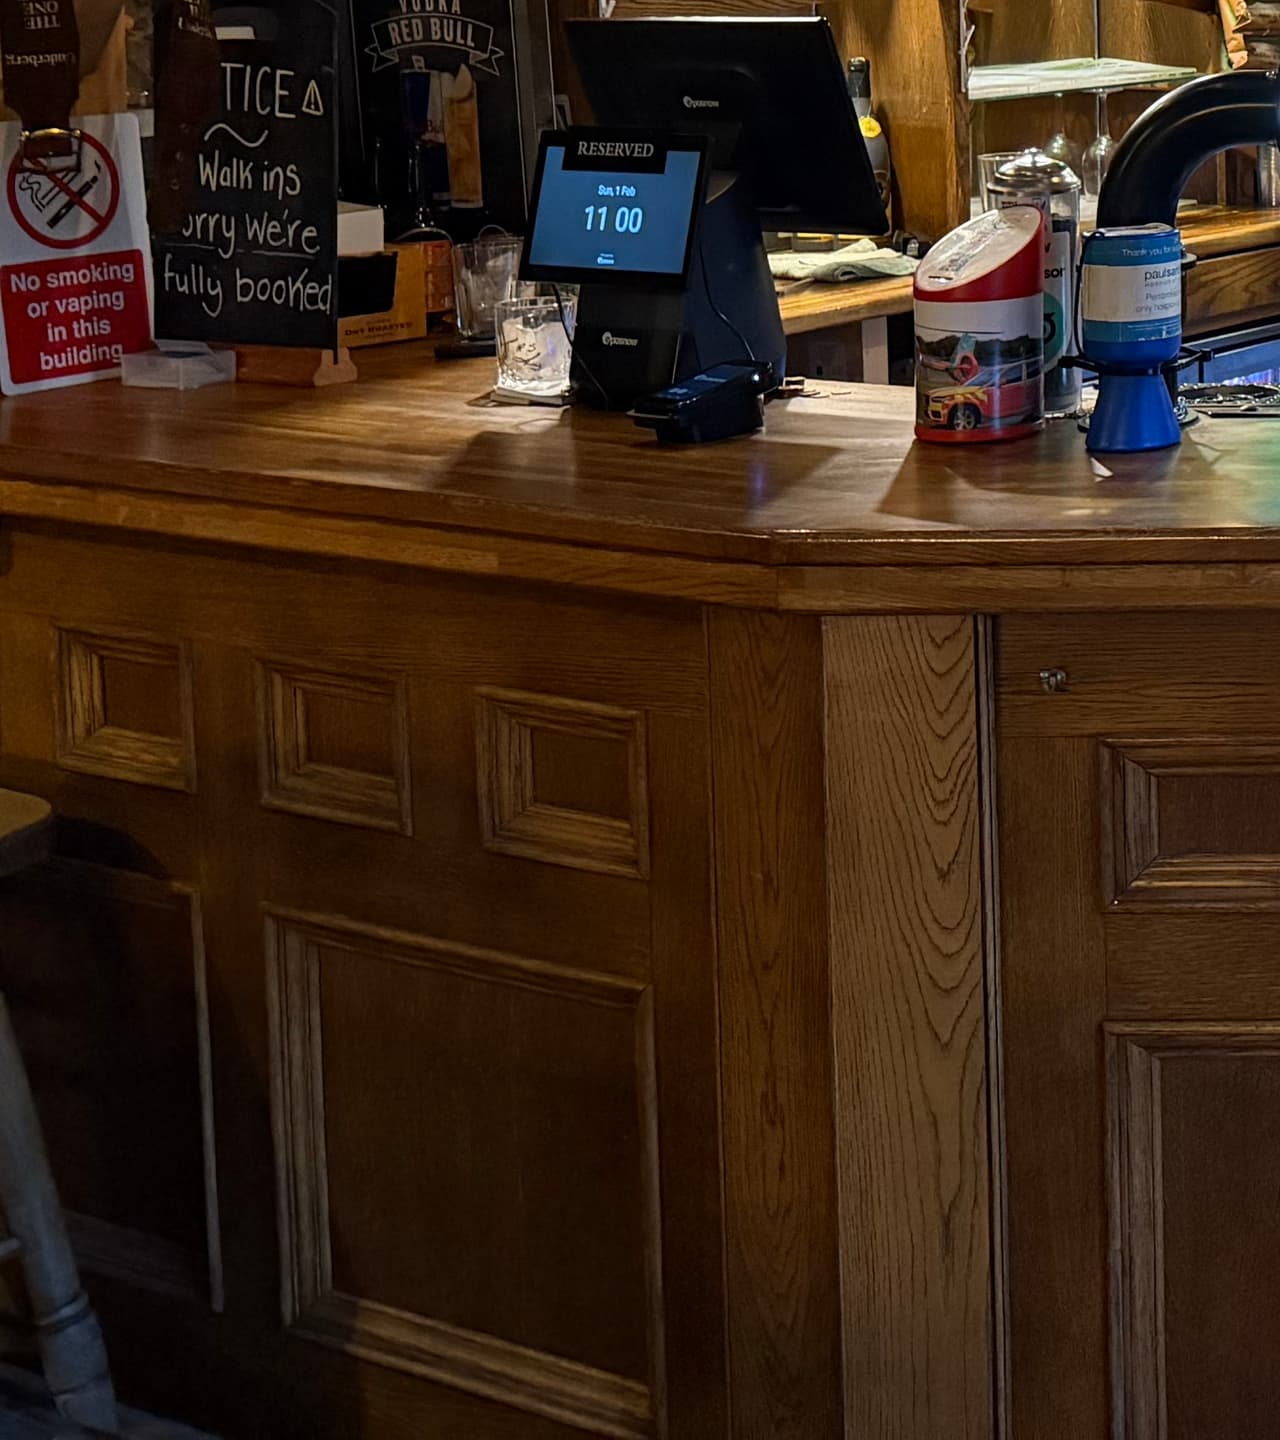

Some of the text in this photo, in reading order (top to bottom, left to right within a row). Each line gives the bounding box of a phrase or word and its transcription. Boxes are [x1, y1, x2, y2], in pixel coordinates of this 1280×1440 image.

[387, 17, 476, 48] RED BULL
[221, 62, 297, 119] TICE
[577, 141, 655, 158] RESERVED
[199, 149, 302, 201] Walk ins
[182, 213, 236, 259] rry
[1122, 248, 1148, 259] Thank
[10, 262, 135, 293] No smoking
[164, 252, 333, 318] fully booked
[27, 290, 125, 319] or vaping
[47, 317, 112, 342] in this
[40, 343, 124, 371] building
